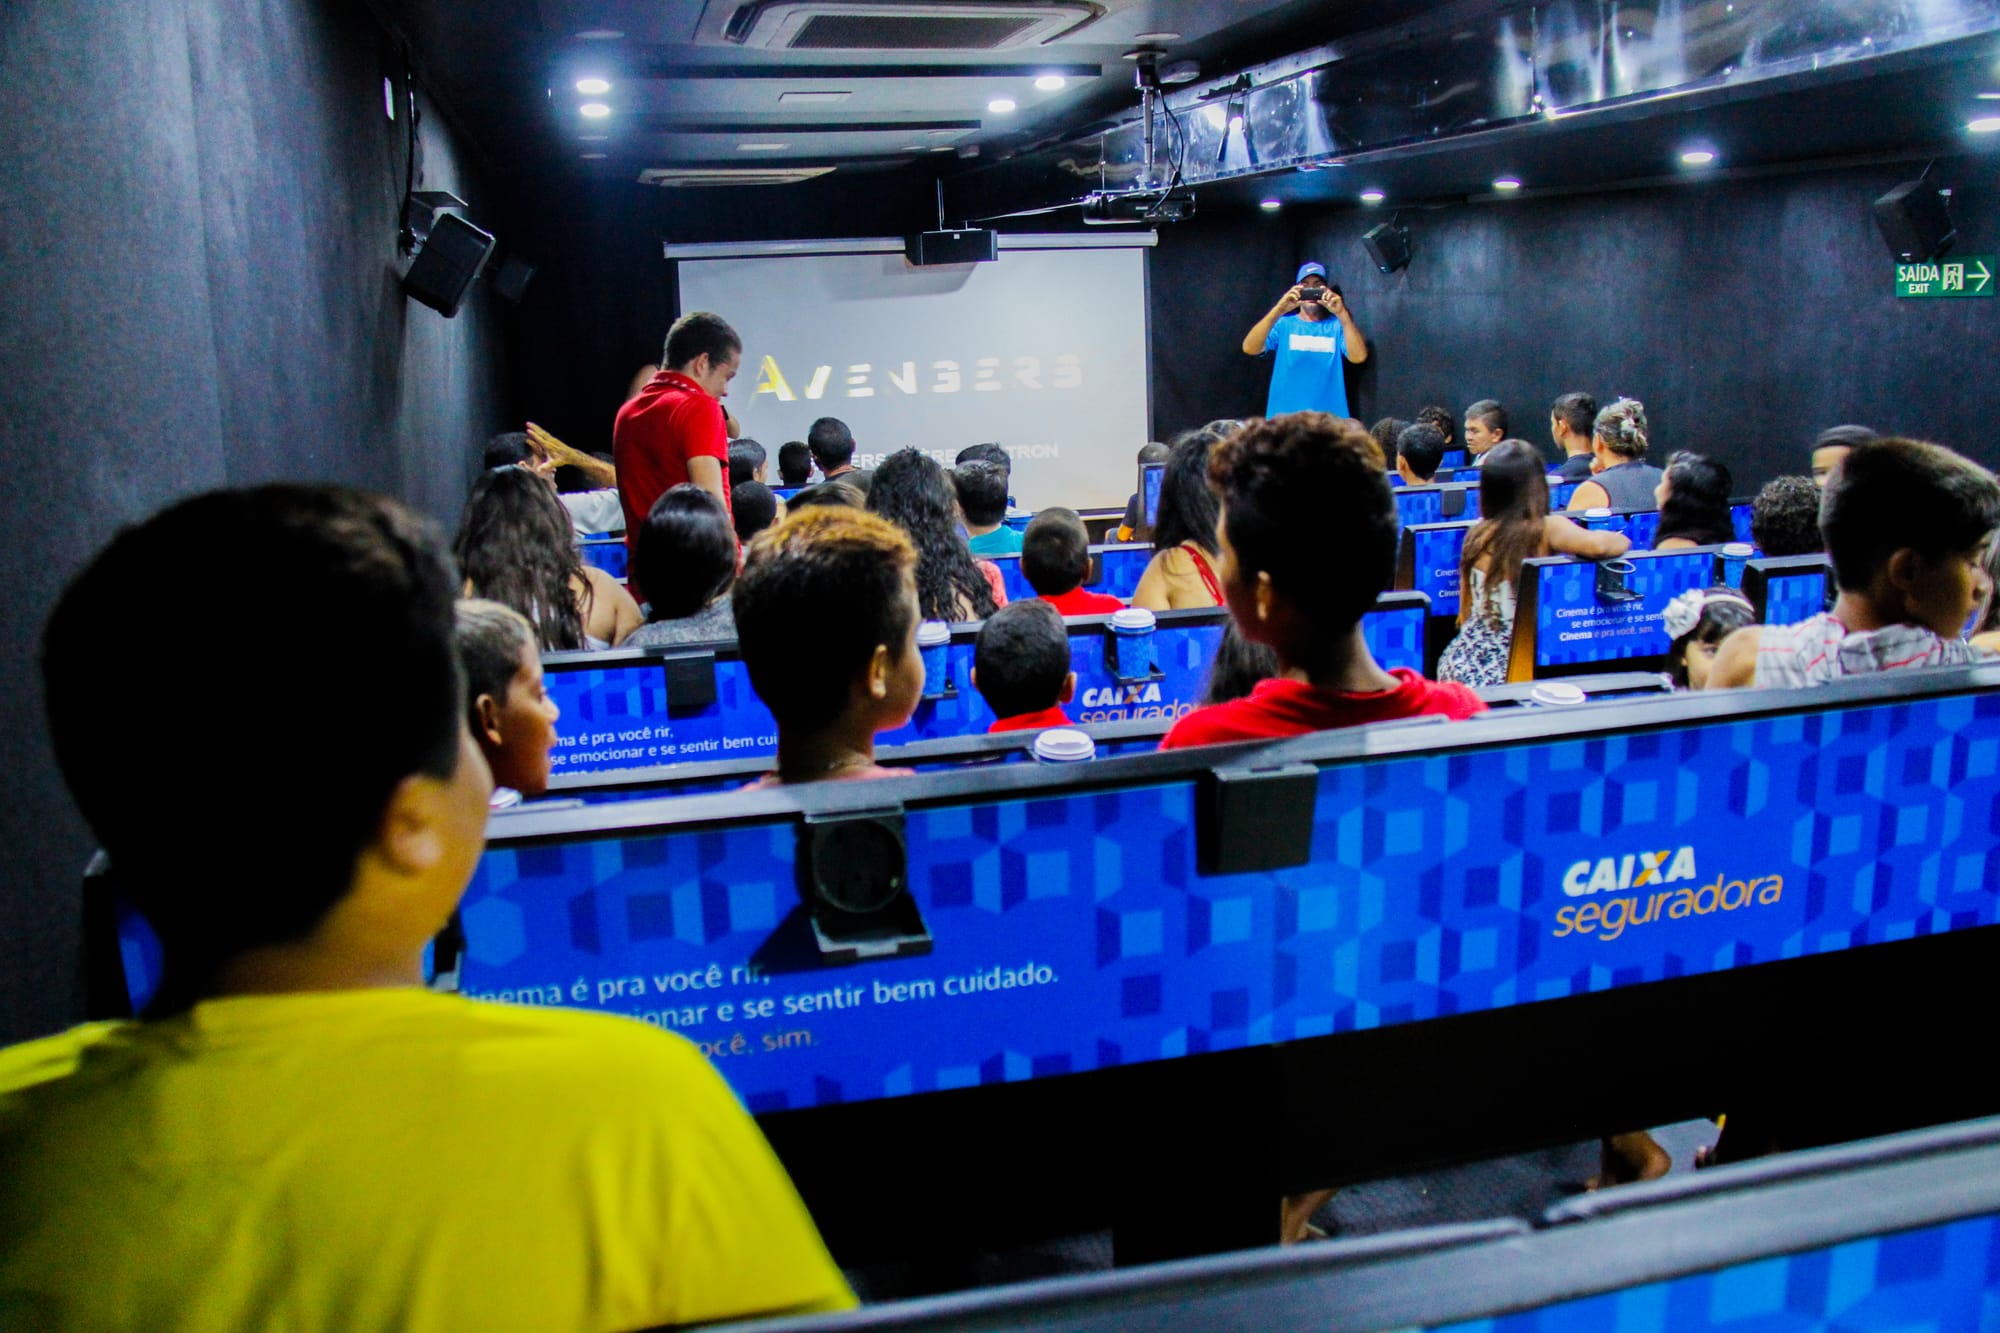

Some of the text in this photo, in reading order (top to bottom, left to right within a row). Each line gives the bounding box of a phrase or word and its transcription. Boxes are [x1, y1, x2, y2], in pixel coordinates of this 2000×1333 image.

[1898, 263, 1940, 282] SAÍDA
[1908, 283, 1930, 294] EXIT
[1006, 443, 1059, 460] TRON
[1556, 608, 1588, 618] Cinema
[1571, 620, 1581, 629] se
[1635, 614, 1644, 622] se
[1560, 631, 1592, 642] Cinema
[1082, 683, 1161, 708] CAIXA
[1080, 698, 1193, 723] segurado
[579, 732, 588, 745] é
[592, 732, 615, 747] pra
[618, 726, 651, 742] você
[655, 725, 674, 739] rir,
[550, 755, 566, 766] se
[570, 748, 644, 764] emocionar
[648, 747, 657, 757] e
[660, 745, 676, 756] se
[680, 739, 720, 754] sentir
[723, 737, 754, 750] bem
[1562, 845, 1697, 898] CAIXA
[1553, 873, 1784, 941] seguradora
[571, 976, 588, 1002] é
[598, 976, 646, 1005] pra
[654, 964, 722, 993] você
[716, 1003, 734, 1022] e
[742, 998, 775, 1019] se
[783, 982, 865, 1015] sentir
[873, 980, 936, 1004] bem
[943, 962, 1059, 996] cuidado.
[699, 1033, 753, 1059] ocê,
